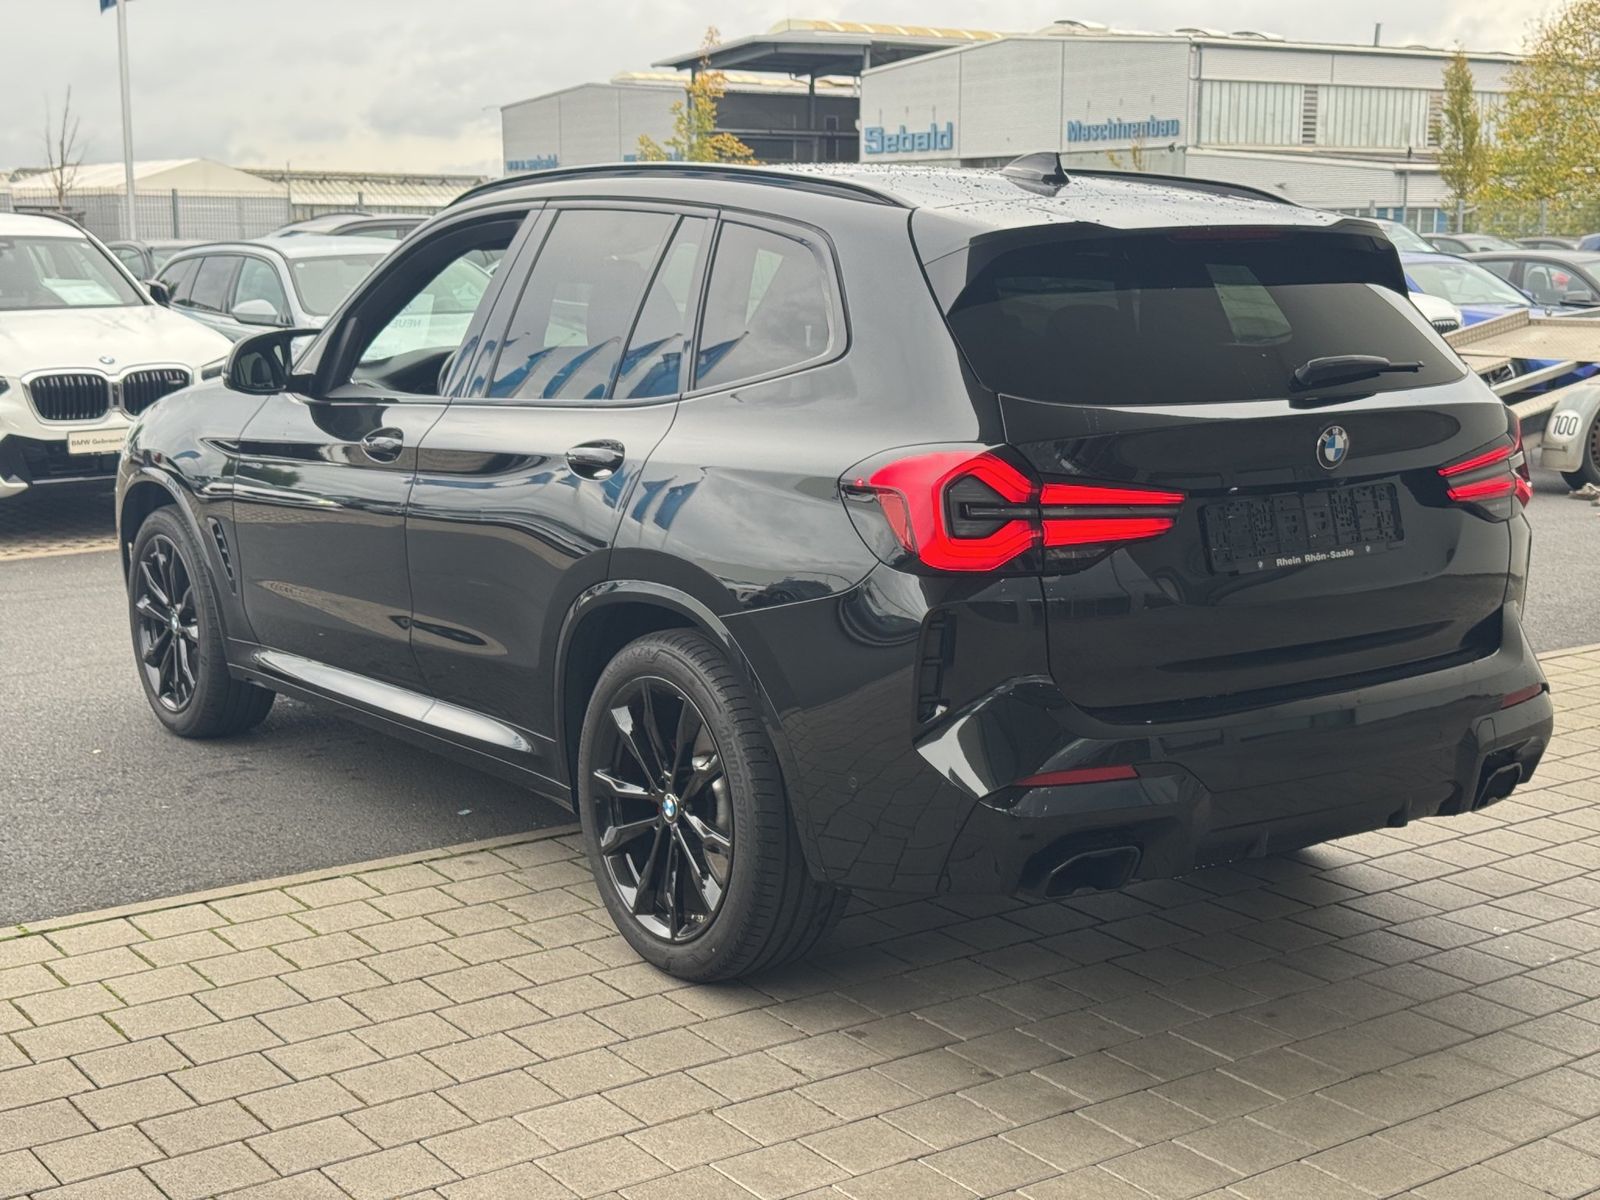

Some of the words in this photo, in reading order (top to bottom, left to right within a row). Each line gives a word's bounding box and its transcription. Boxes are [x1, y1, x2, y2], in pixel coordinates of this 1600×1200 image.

[864, 122, 953, 154] Sebald
[1067, 115, 1180, 143] Maschinenbau
[1553, 415, 1579, 436] 100
[1276, 556, 1301, 567] Rhein
